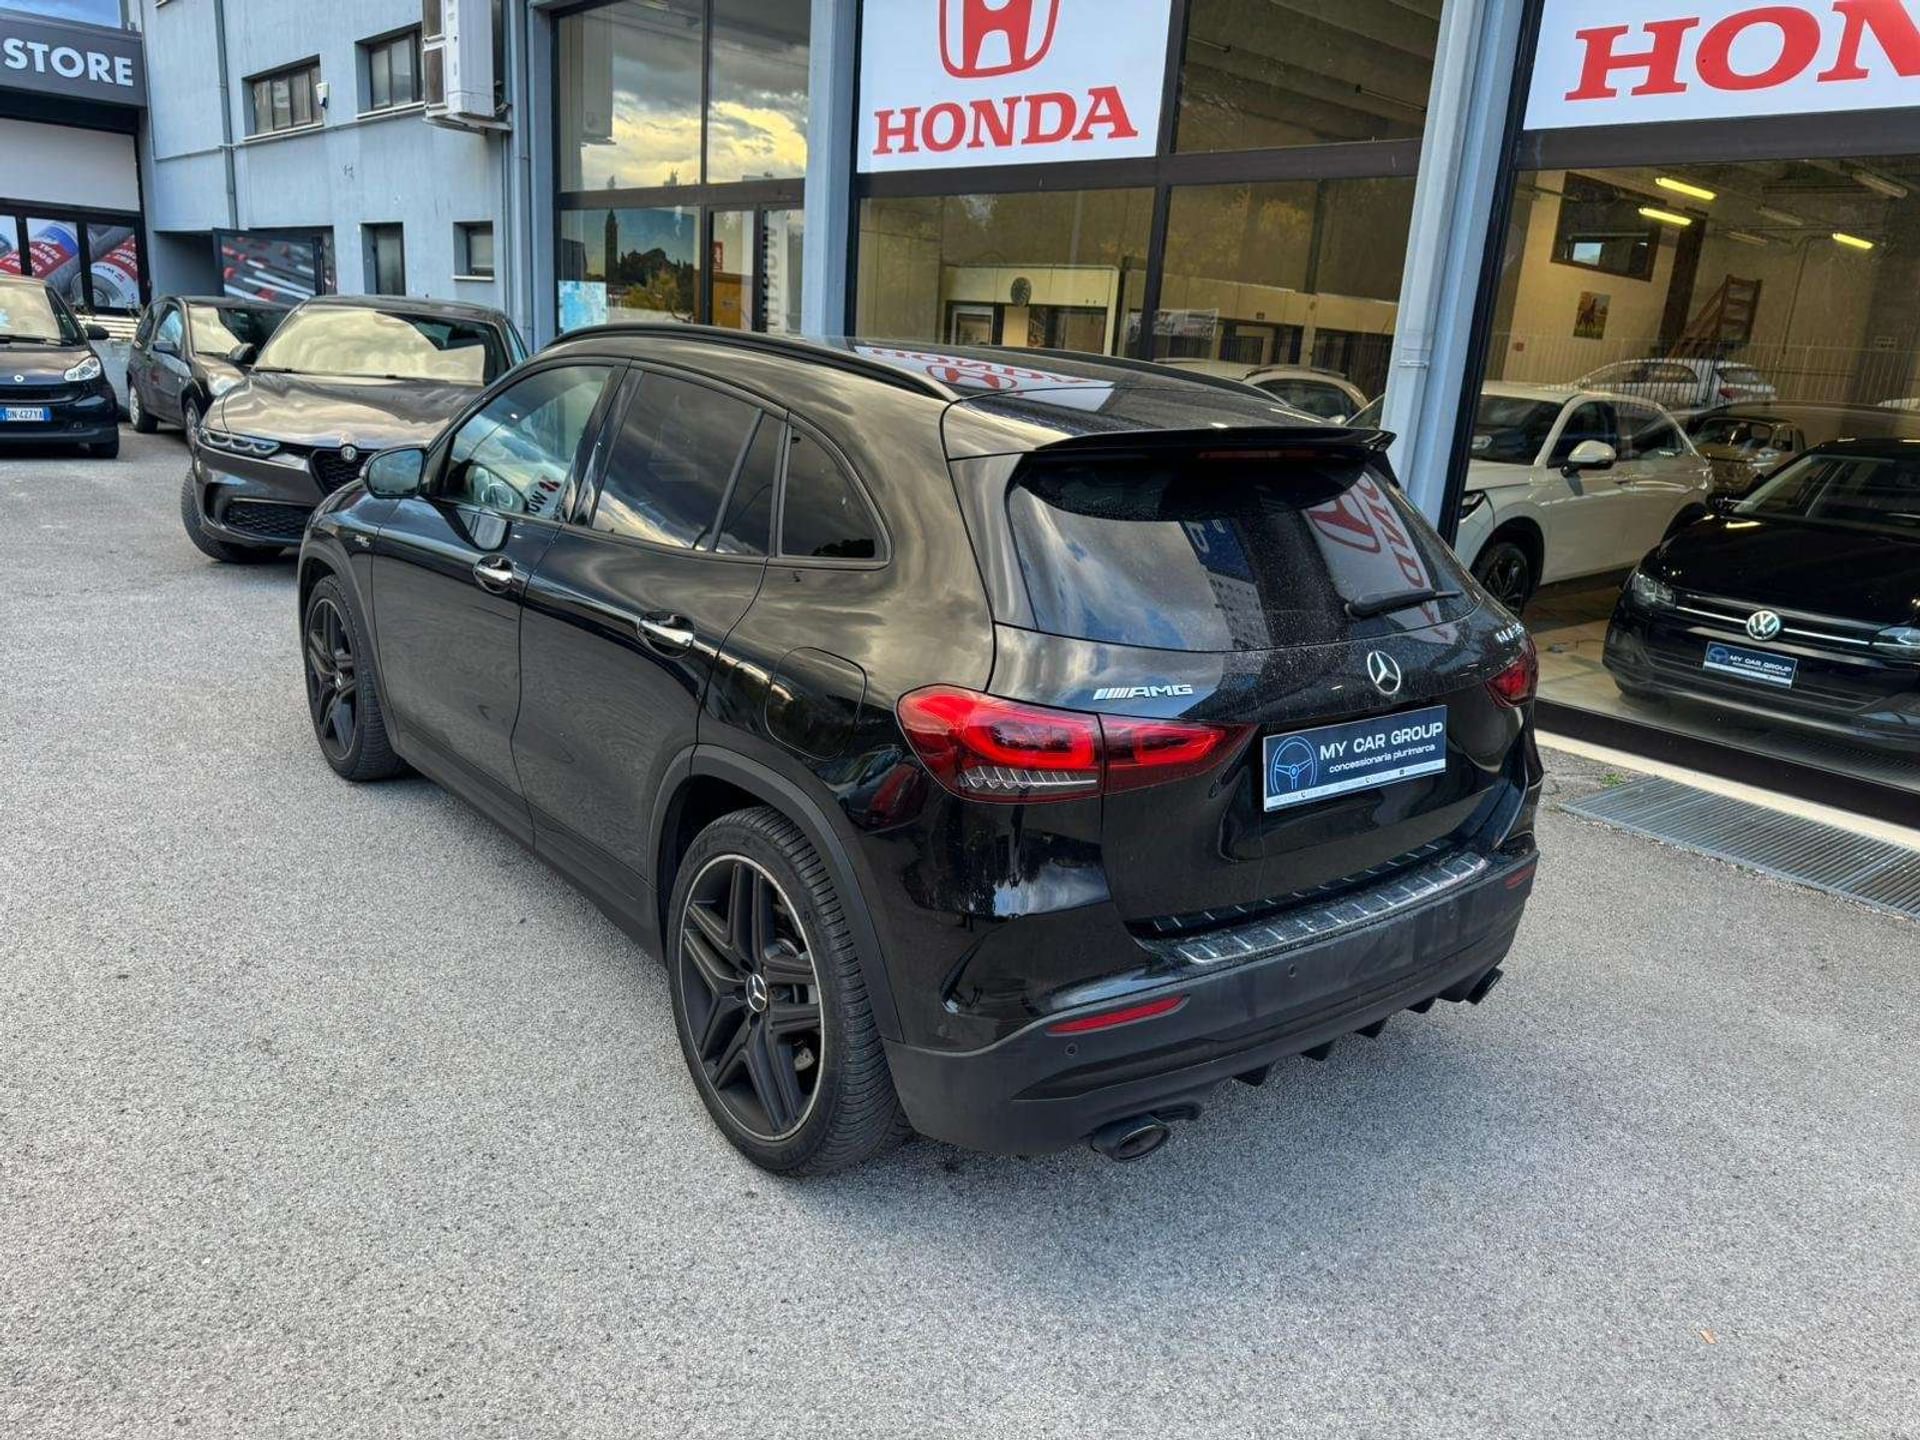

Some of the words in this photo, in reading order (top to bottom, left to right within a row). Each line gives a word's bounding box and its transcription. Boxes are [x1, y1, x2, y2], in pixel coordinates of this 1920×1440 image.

[3, 38, 133, 87] STORE
[872, 85, 1139, 156] HONDA
[1122, 684, 1194, 699] AMG
[1319, 740, 1348, 761] MY
[1353, 733, 1386, 754] CAR
[1391, 722, 1444, 746] GROUP
[1328, 752, 1392, 774] concessionaria
[1392, 743, 1436, 761] plurimarca
